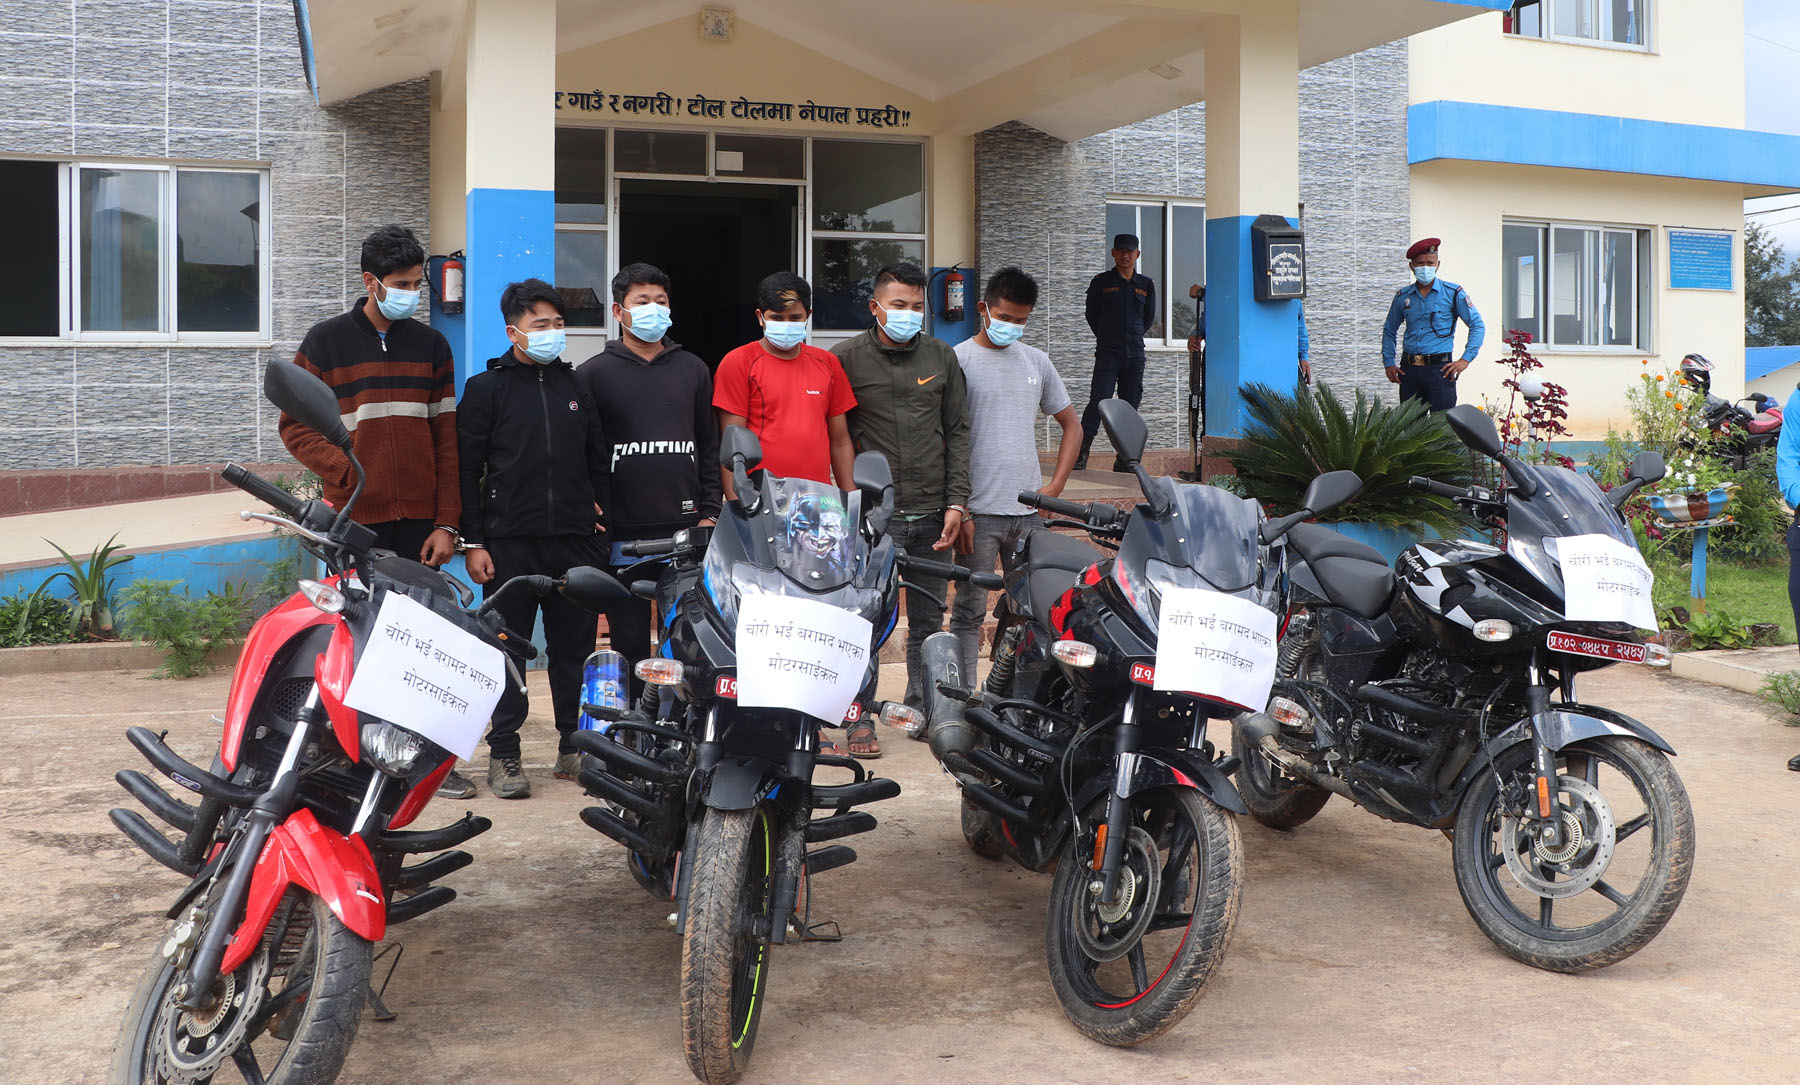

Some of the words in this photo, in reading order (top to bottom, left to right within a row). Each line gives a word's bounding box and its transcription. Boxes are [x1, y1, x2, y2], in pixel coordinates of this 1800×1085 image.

[568, 89, 604, 112] गाउँ
[609, 94, 621, 114] र
[687, 93, 727, 118] टोल
[731, 96, 793, 122] टोलमा
[799, 99, 851, 124] नेपाल
[745, 618, 770, 637] चोरी
[774, 621, 794, 640] भई
[797, 627, 835, 648] बरामद
[1169, 609, 1194, 627] चोरी
[1198, 613, 1217, 631] भई
[1219, 619, 1251, 641] बरामद
[384, 622, 412, 647] चोरी
[415, 635, 432, 657] भई
[433, 648, 467, 676] बरामद
